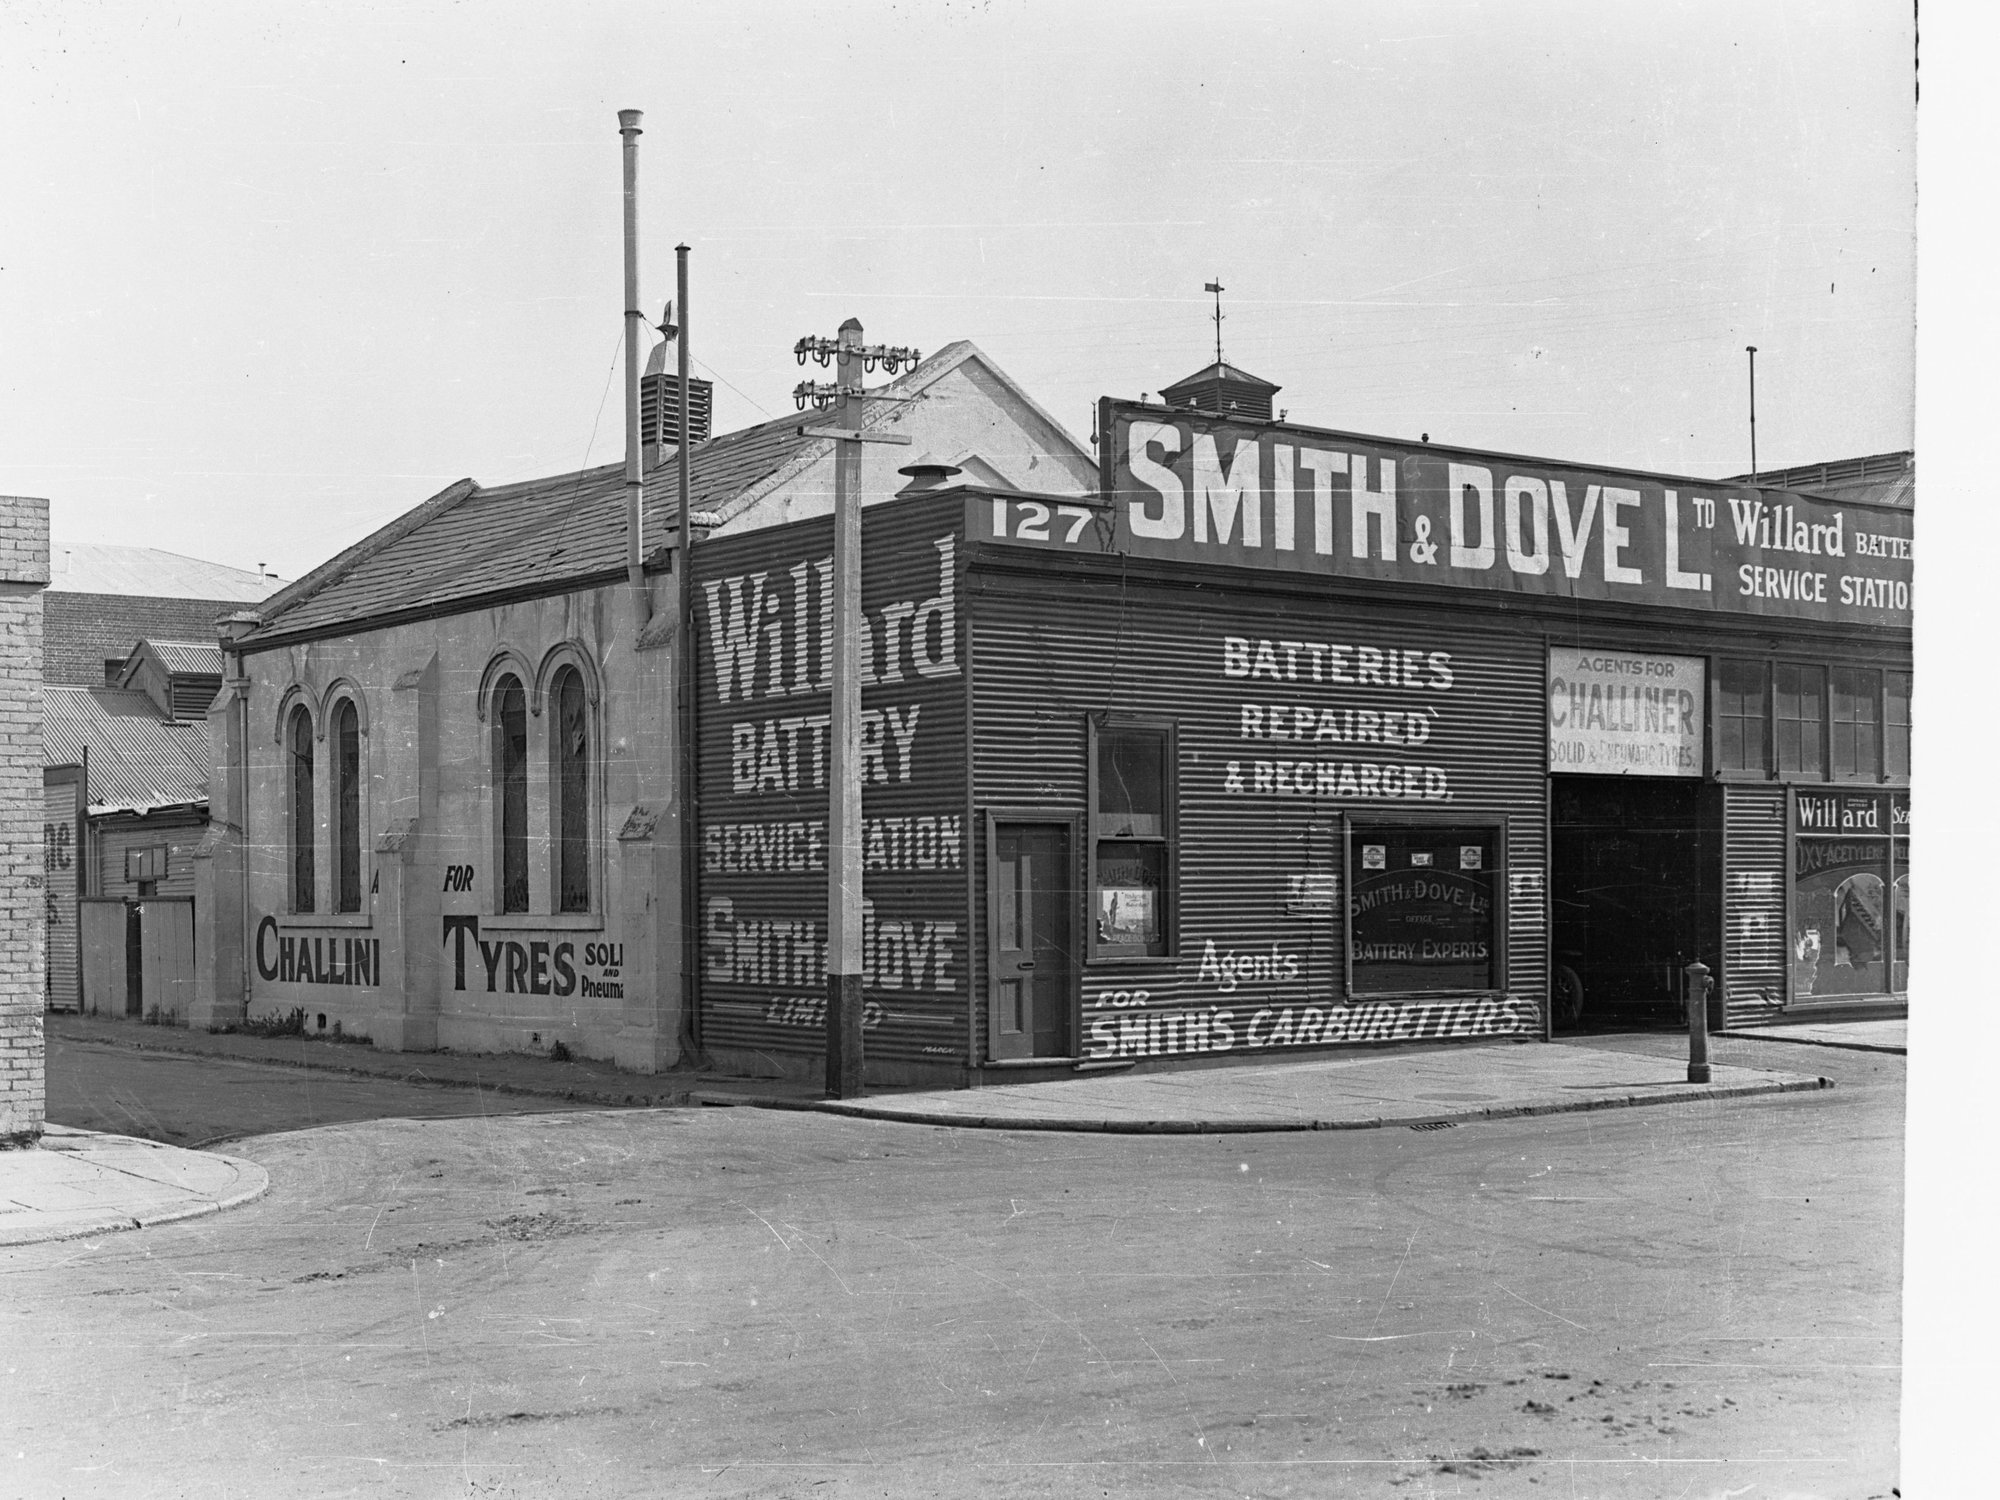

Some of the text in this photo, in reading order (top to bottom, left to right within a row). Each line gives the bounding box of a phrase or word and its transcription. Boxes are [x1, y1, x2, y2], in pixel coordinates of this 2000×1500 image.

[992, 499, 1093, 543] 127
[1129, 421, 1396, 561] SMITH
[1410, 515, 1438, 565] &
[1449, 463, 1642, 584] DOVE
[1728, 498, 1846, 557] Willard
[1739, 564, 1914, 610] SERVICE STATIO
[1225, 637, 1455, 690] BATTERIES
[1577, 657, 1675, 677] AGENTS FOR
[1241, 704, 1431, 745] REPAIRED
[1551, 677, 1694, 735] CHALLINER
[732, 703, 921, 794] BATTRY
[1551, 738, 1585, 764] SOLID
[1588, 744, 1597, 764] &
[1225, 761, 1244, 793] &
[705, 815, 961, 873] SERVICE ATION
[443, 865, 474, 892] FOR
[1351, 883, 1403, 917] SMITH
[1415, 880, 1465, 906] DOVE
[1405, 915, 1433, 923] OFFICE
[443, 915, 577, 996] TYRES
[707, 897, 816, 986] SMITH
[1352, 940, 1416, 961] BATTERY
[603, 968, 619, 977] AND
[1197, 940, 1298, 992] Agents
[1096, 990, 1150, 1008] FOR
